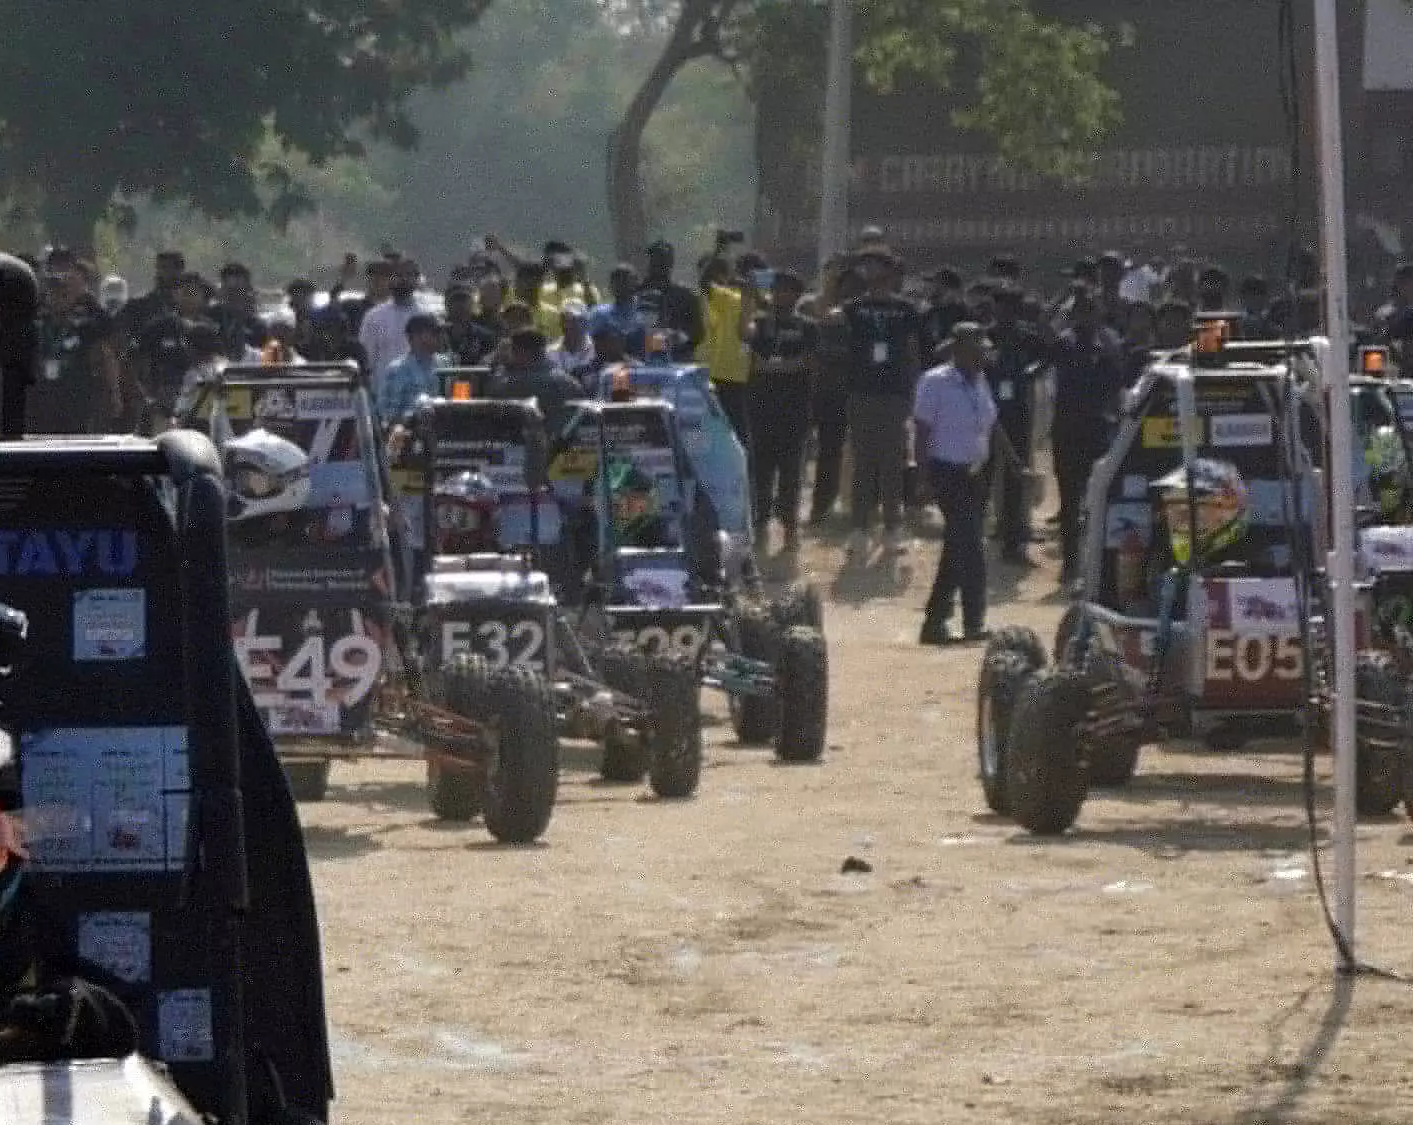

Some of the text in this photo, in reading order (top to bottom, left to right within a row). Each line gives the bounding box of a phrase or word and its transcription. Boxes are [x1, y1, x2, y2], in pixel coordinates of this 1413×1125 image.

[233, 634, 382, 708] E49
[441, 619, 545, 672] E32
[1206, 629, 1305, 681] E05
